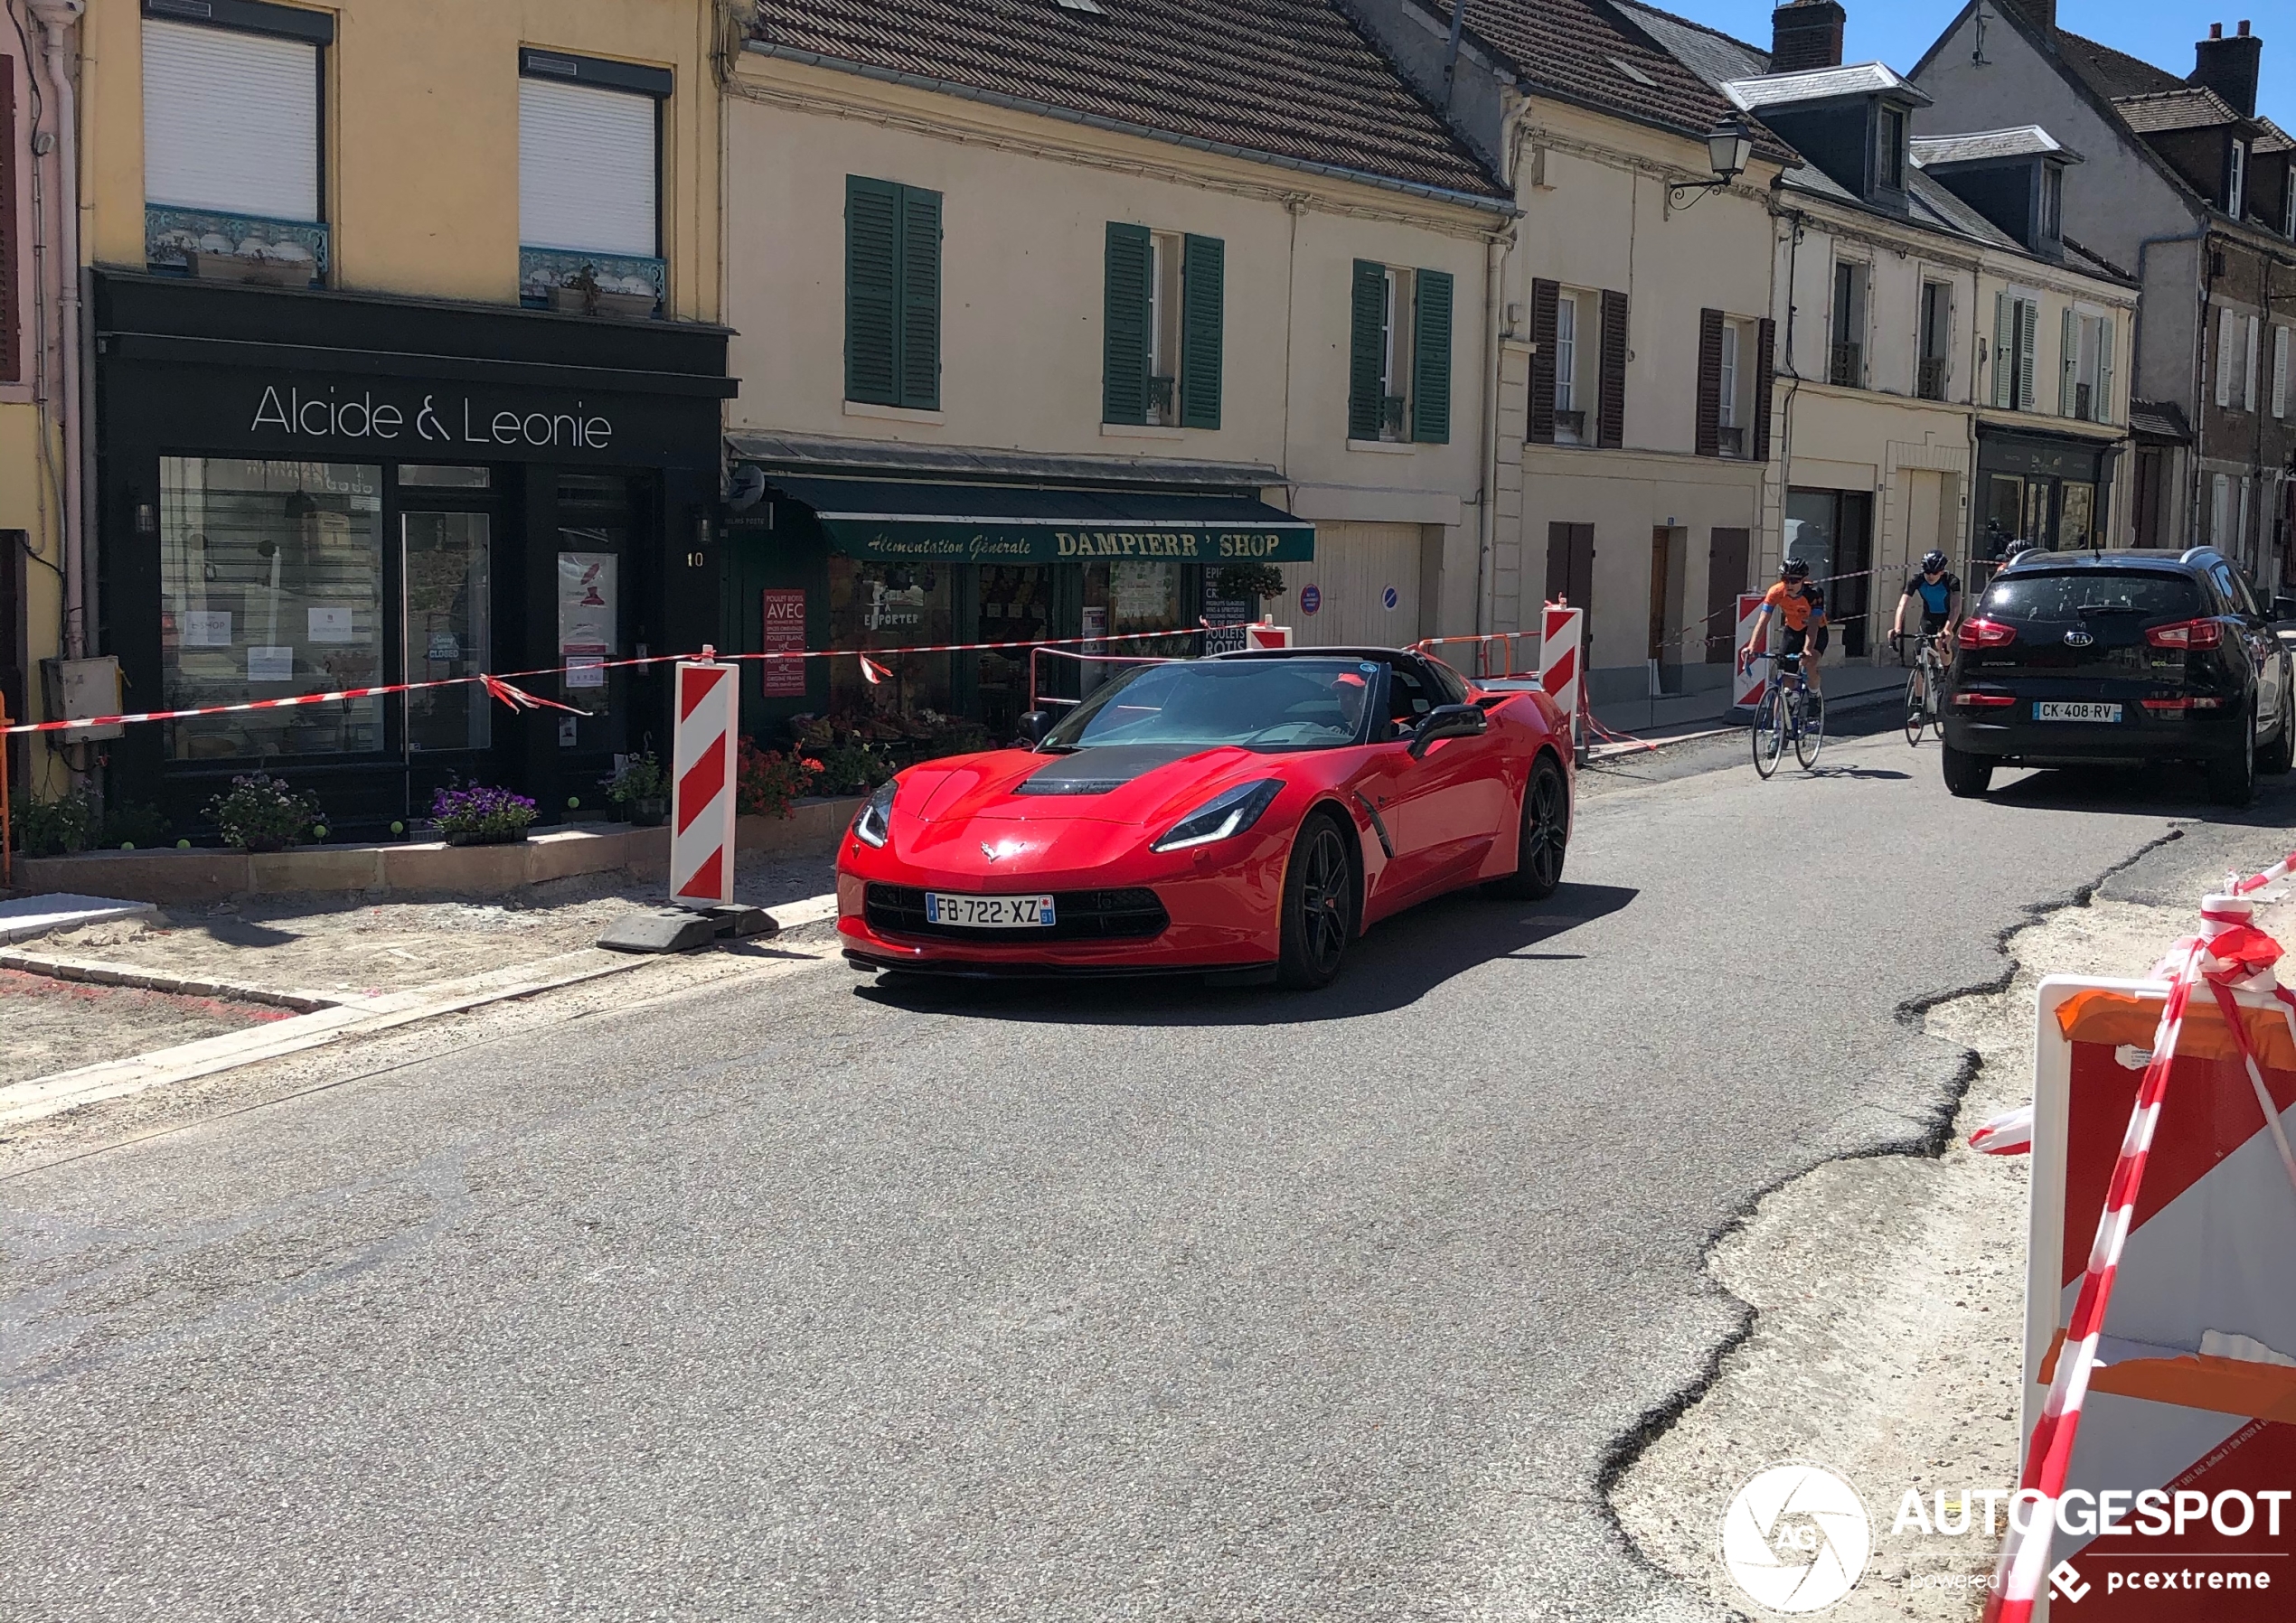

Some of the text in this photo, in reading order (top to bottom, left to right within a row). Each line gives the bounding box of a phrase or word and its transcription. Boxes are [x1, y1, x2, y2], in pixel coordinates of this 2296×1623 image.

[251, 385, 613, 449] Alcide & Leonie
[867, 531, 1031, 561] Alimentation Générale
[1219, 533, 1280, 558] SHOP
[687, 552, 703, 567] 10
[767, 603, 804, 619] AVEC
[864, 614, 919, 626] EPORTER
[1206, 627, 1245, 640] POULETS
[2068, 634, 2088, 643] KIA
[428, 650, 459, 659] CLOSED
[1206, 641, 1245, 657] ROTIS
[2042, 703, 2112, 718] CK-408-RV
[936, 897, 1040, 923] FB-722-XZ
[1041, 912, 1052, 923] 91
